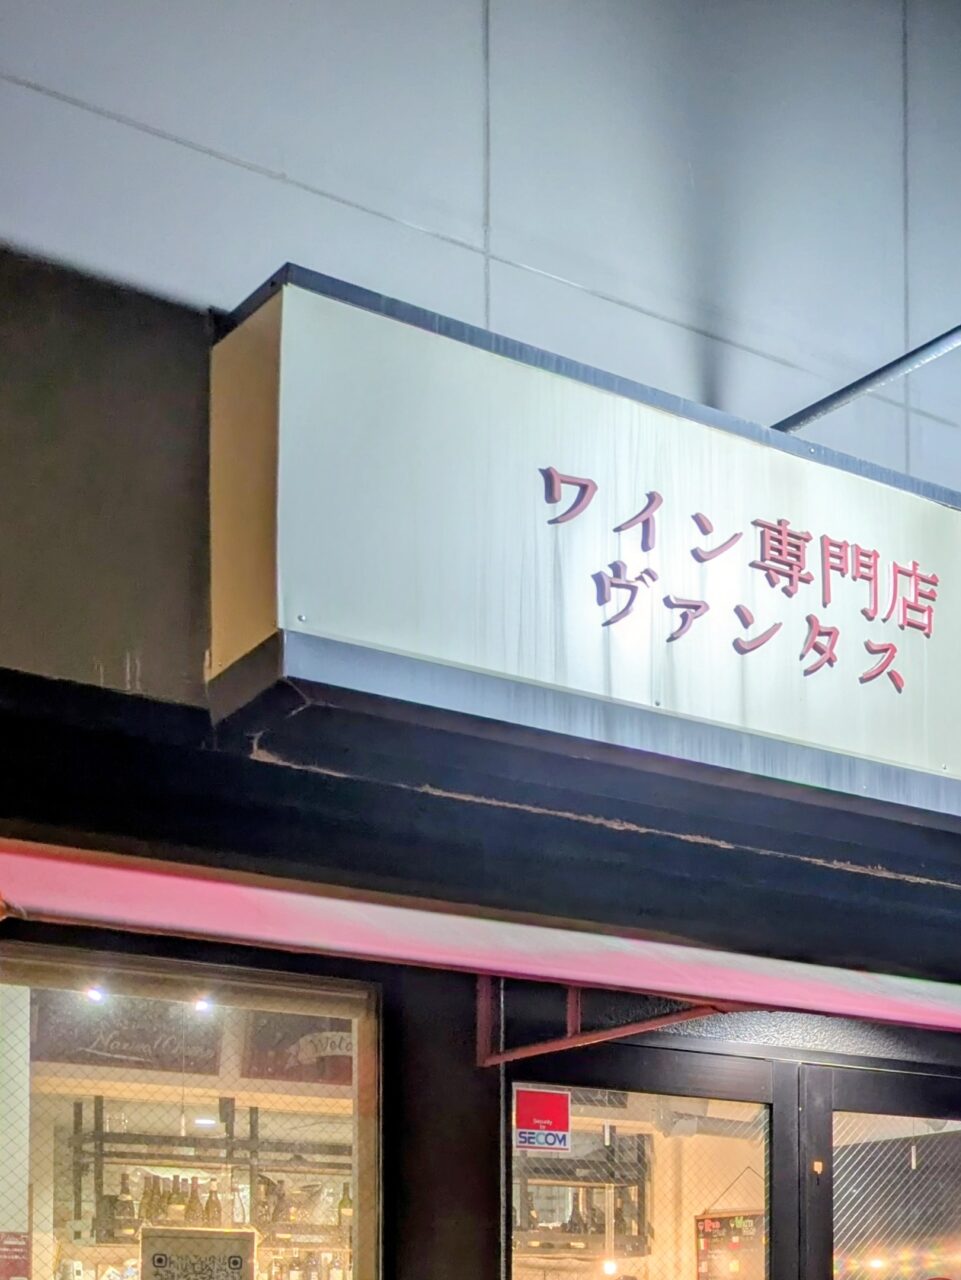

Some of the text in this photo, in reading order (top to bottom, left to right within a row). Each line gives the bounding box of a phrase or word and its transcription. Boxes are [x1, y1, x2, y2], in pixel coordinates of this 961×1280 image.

[538, 466, 939, 638] ワイン専門店
[593, 559, 906, 694] ヴァンタス
[518, 1131, 567, 1147] SECOM
